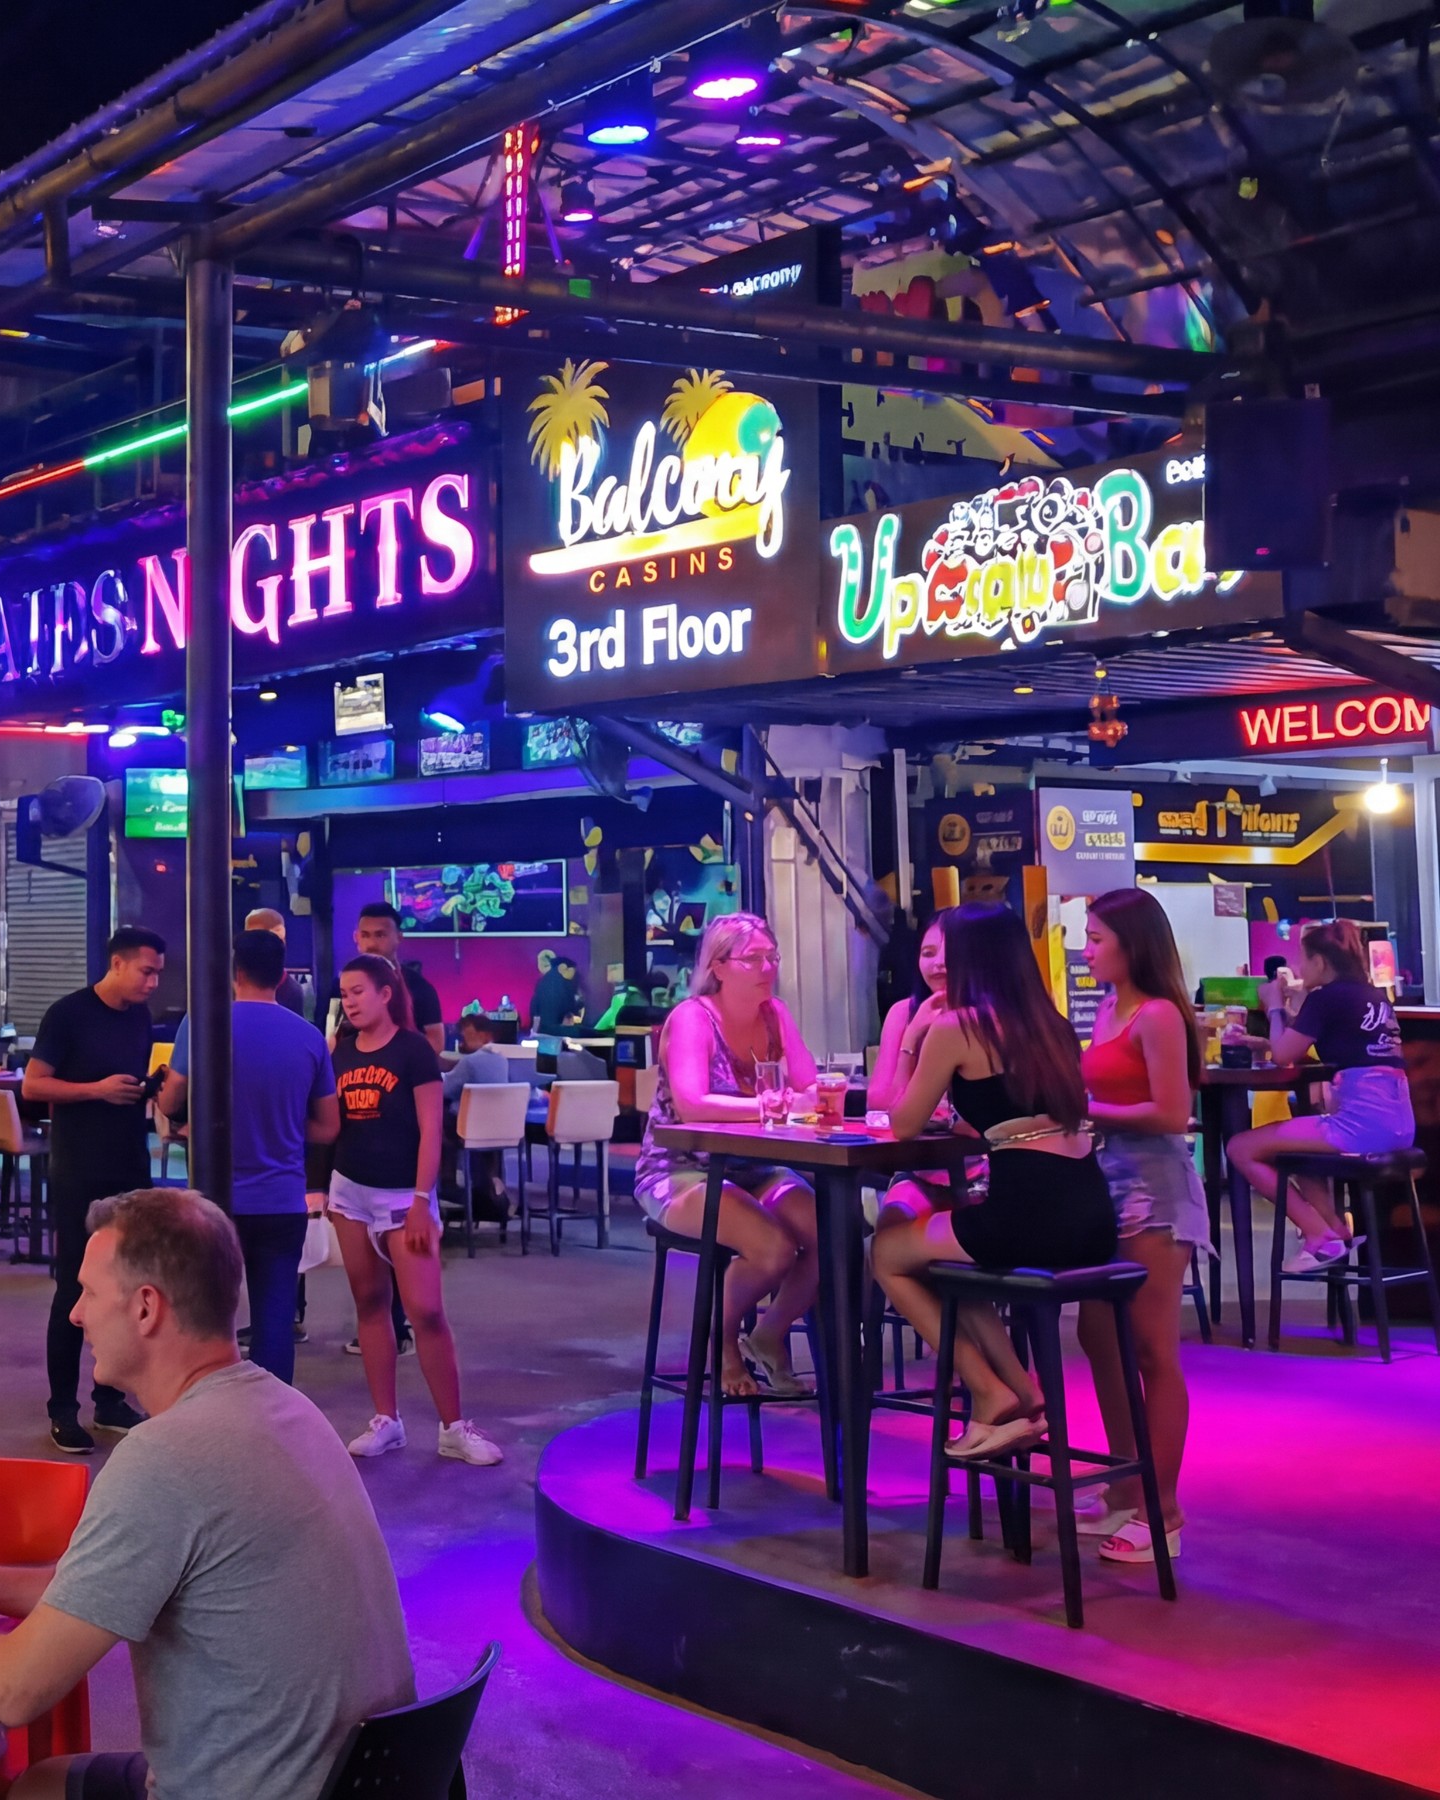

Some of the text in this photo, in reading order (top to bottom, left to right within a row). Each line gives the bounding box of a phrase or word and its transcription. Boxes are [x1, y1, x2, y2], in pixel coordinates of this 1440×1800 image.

[138, 473, 475, 656] NGHTS
[589, 547, 734, 593] CASINS
[548, 603, 752, 678] 3rd Floor
